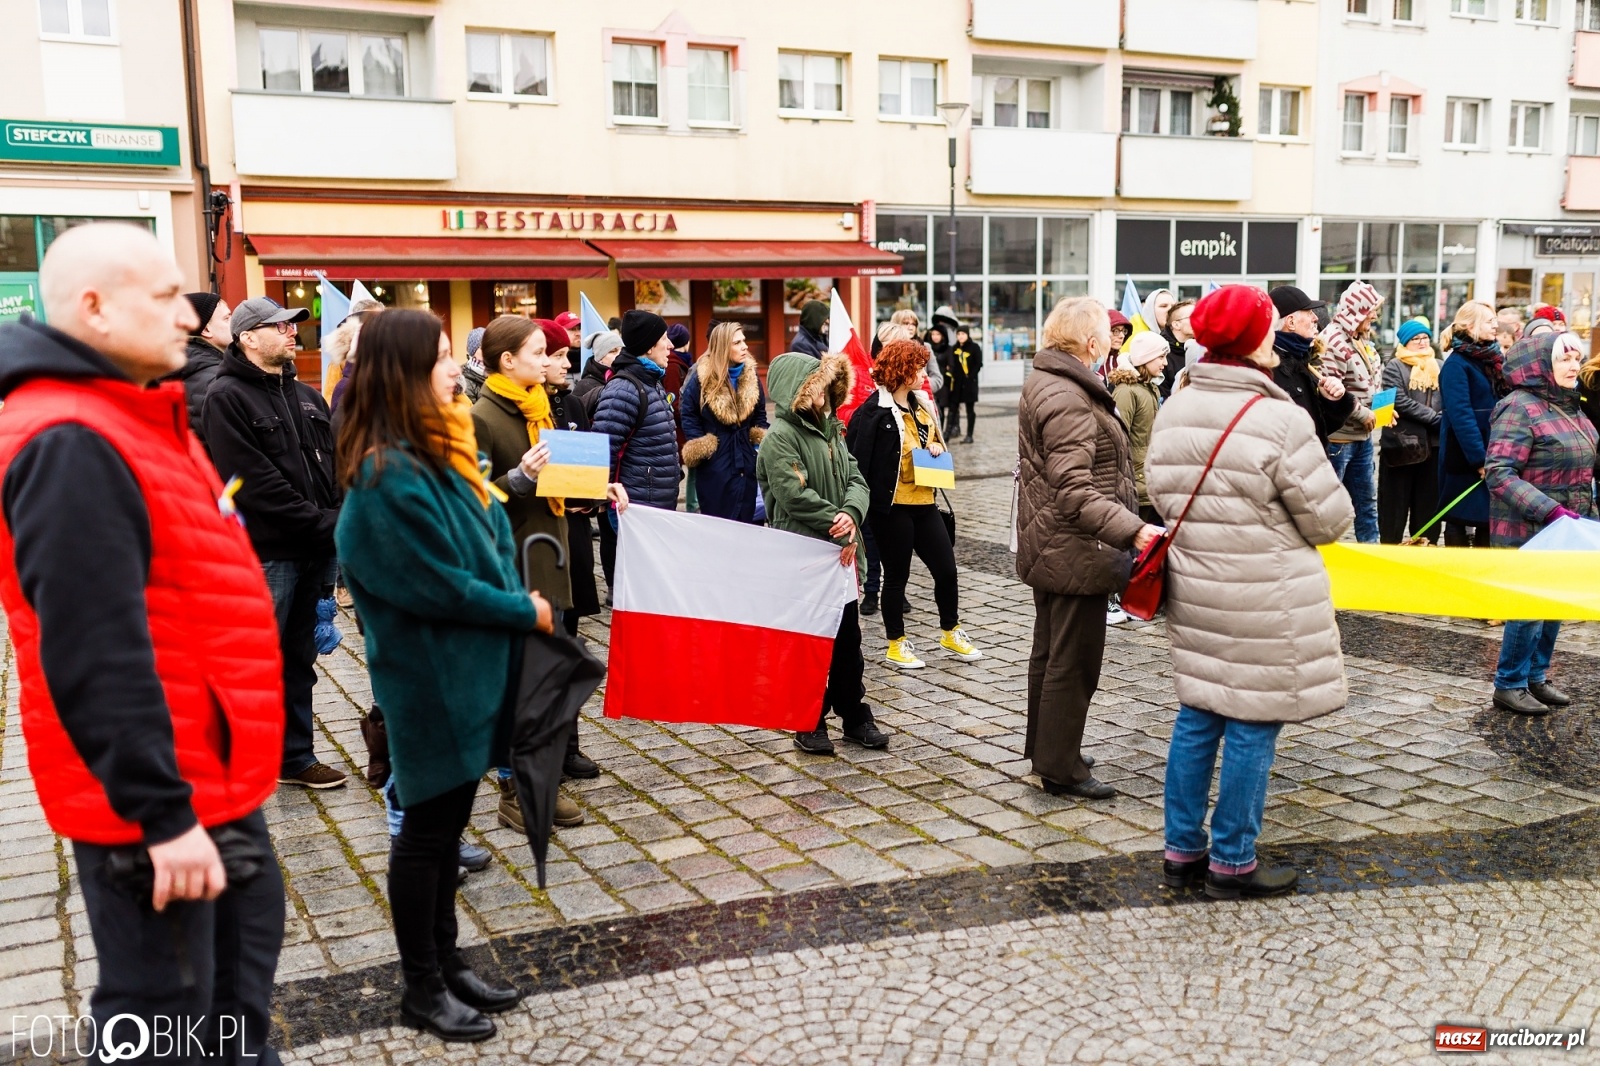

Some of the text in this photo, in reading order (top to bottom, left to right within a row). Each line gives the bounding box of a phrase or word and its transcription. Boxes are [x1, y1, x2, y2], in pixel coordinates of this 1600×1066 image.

[13, 127, 155, 146] STEFCZYK FINANSE
[475, 210, 677, 232] RESTAURACJA
[878, 237, 926, 253] empik.com
[1180, 231, 1237, 260] empik
[0, 295, 23, 308] MY
